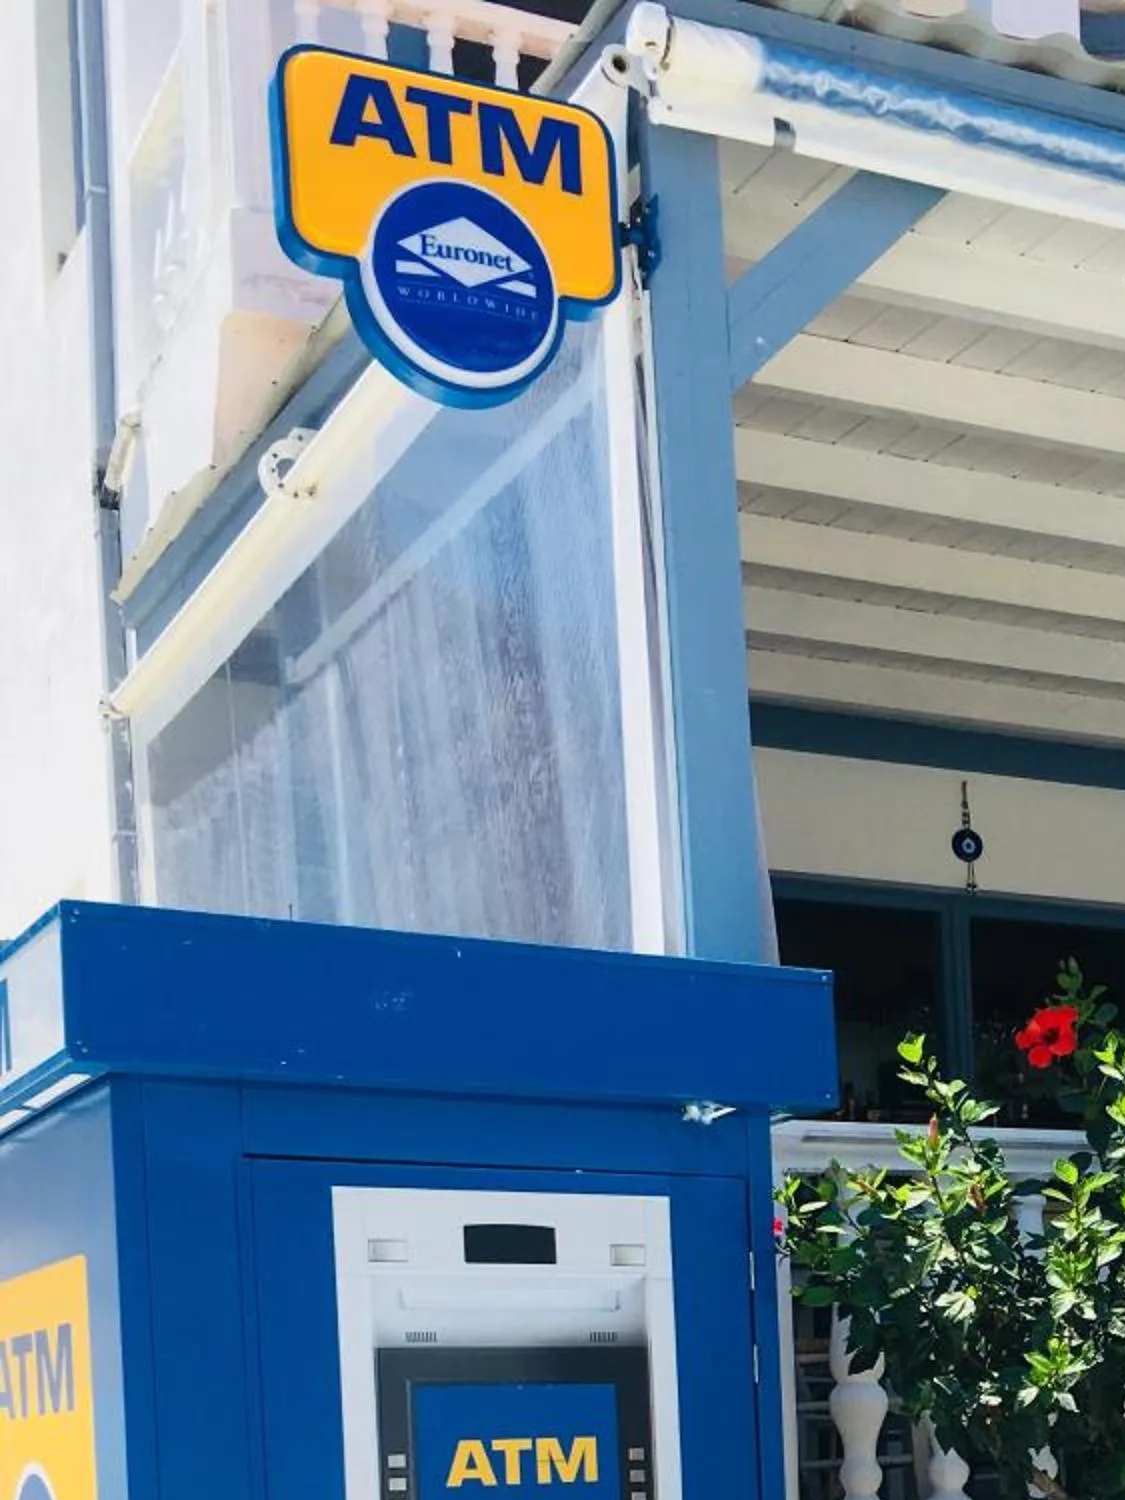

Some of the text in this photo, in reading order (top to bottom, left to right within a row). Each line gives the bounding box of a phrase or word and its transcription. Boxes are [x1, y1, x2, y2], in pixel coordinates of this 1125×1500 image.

[329, 73, 583, 196] ATM
[419, 233, 515, 273] Euronet
[445, 1436, 599, 1488] ATM
